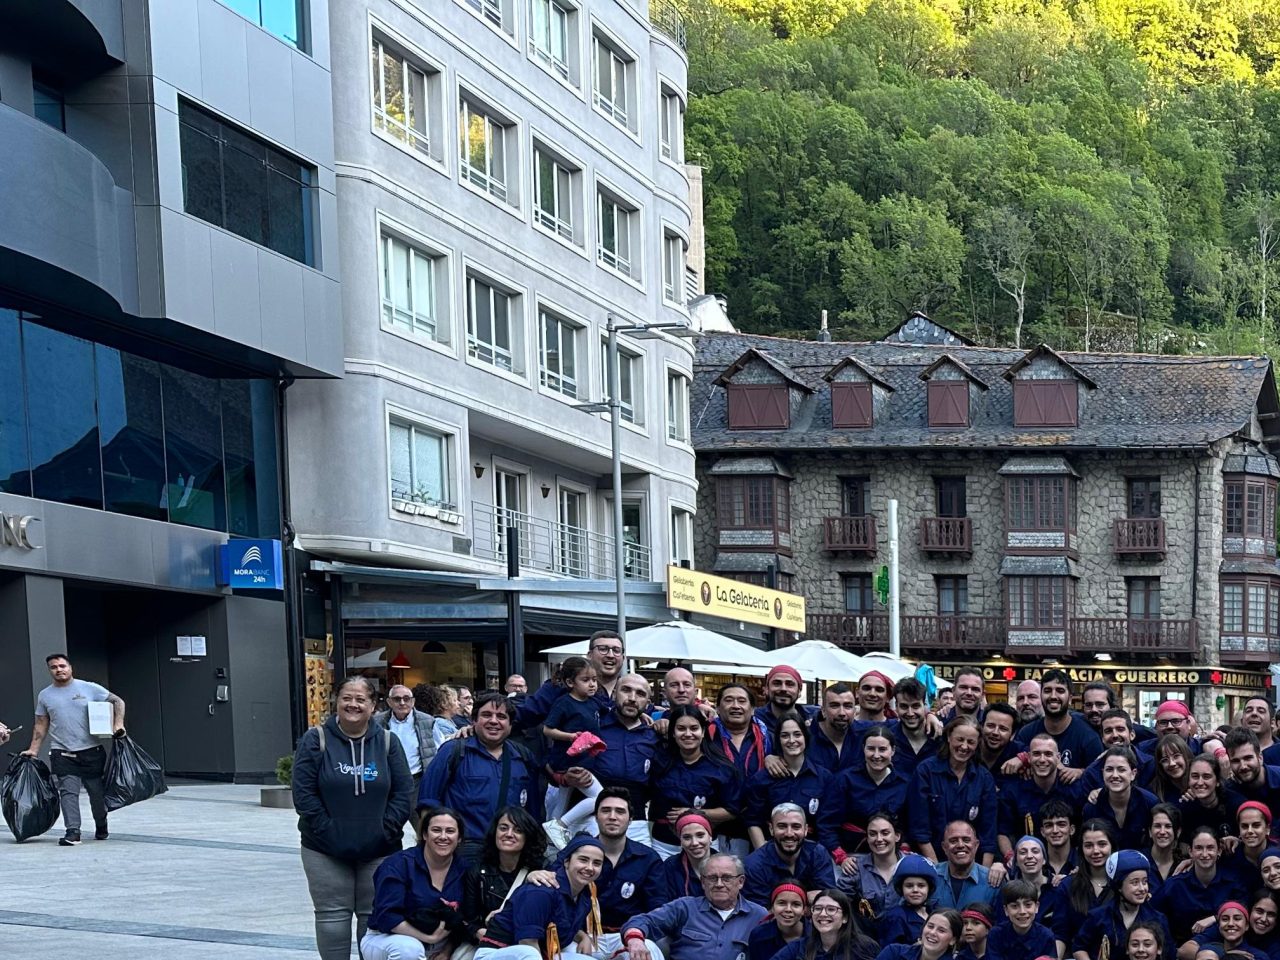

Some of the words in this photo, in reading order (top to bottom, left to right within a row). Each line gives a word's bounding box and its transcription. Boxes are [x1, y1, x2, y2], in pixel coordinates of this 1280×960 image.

[716, 585, 728, 603] La
[1024, 669, 1104, 682] FAACIA
[1115, 671, 1200, 683] GUERRERO
[1222, 672, 1263, 687] FARMACIA
